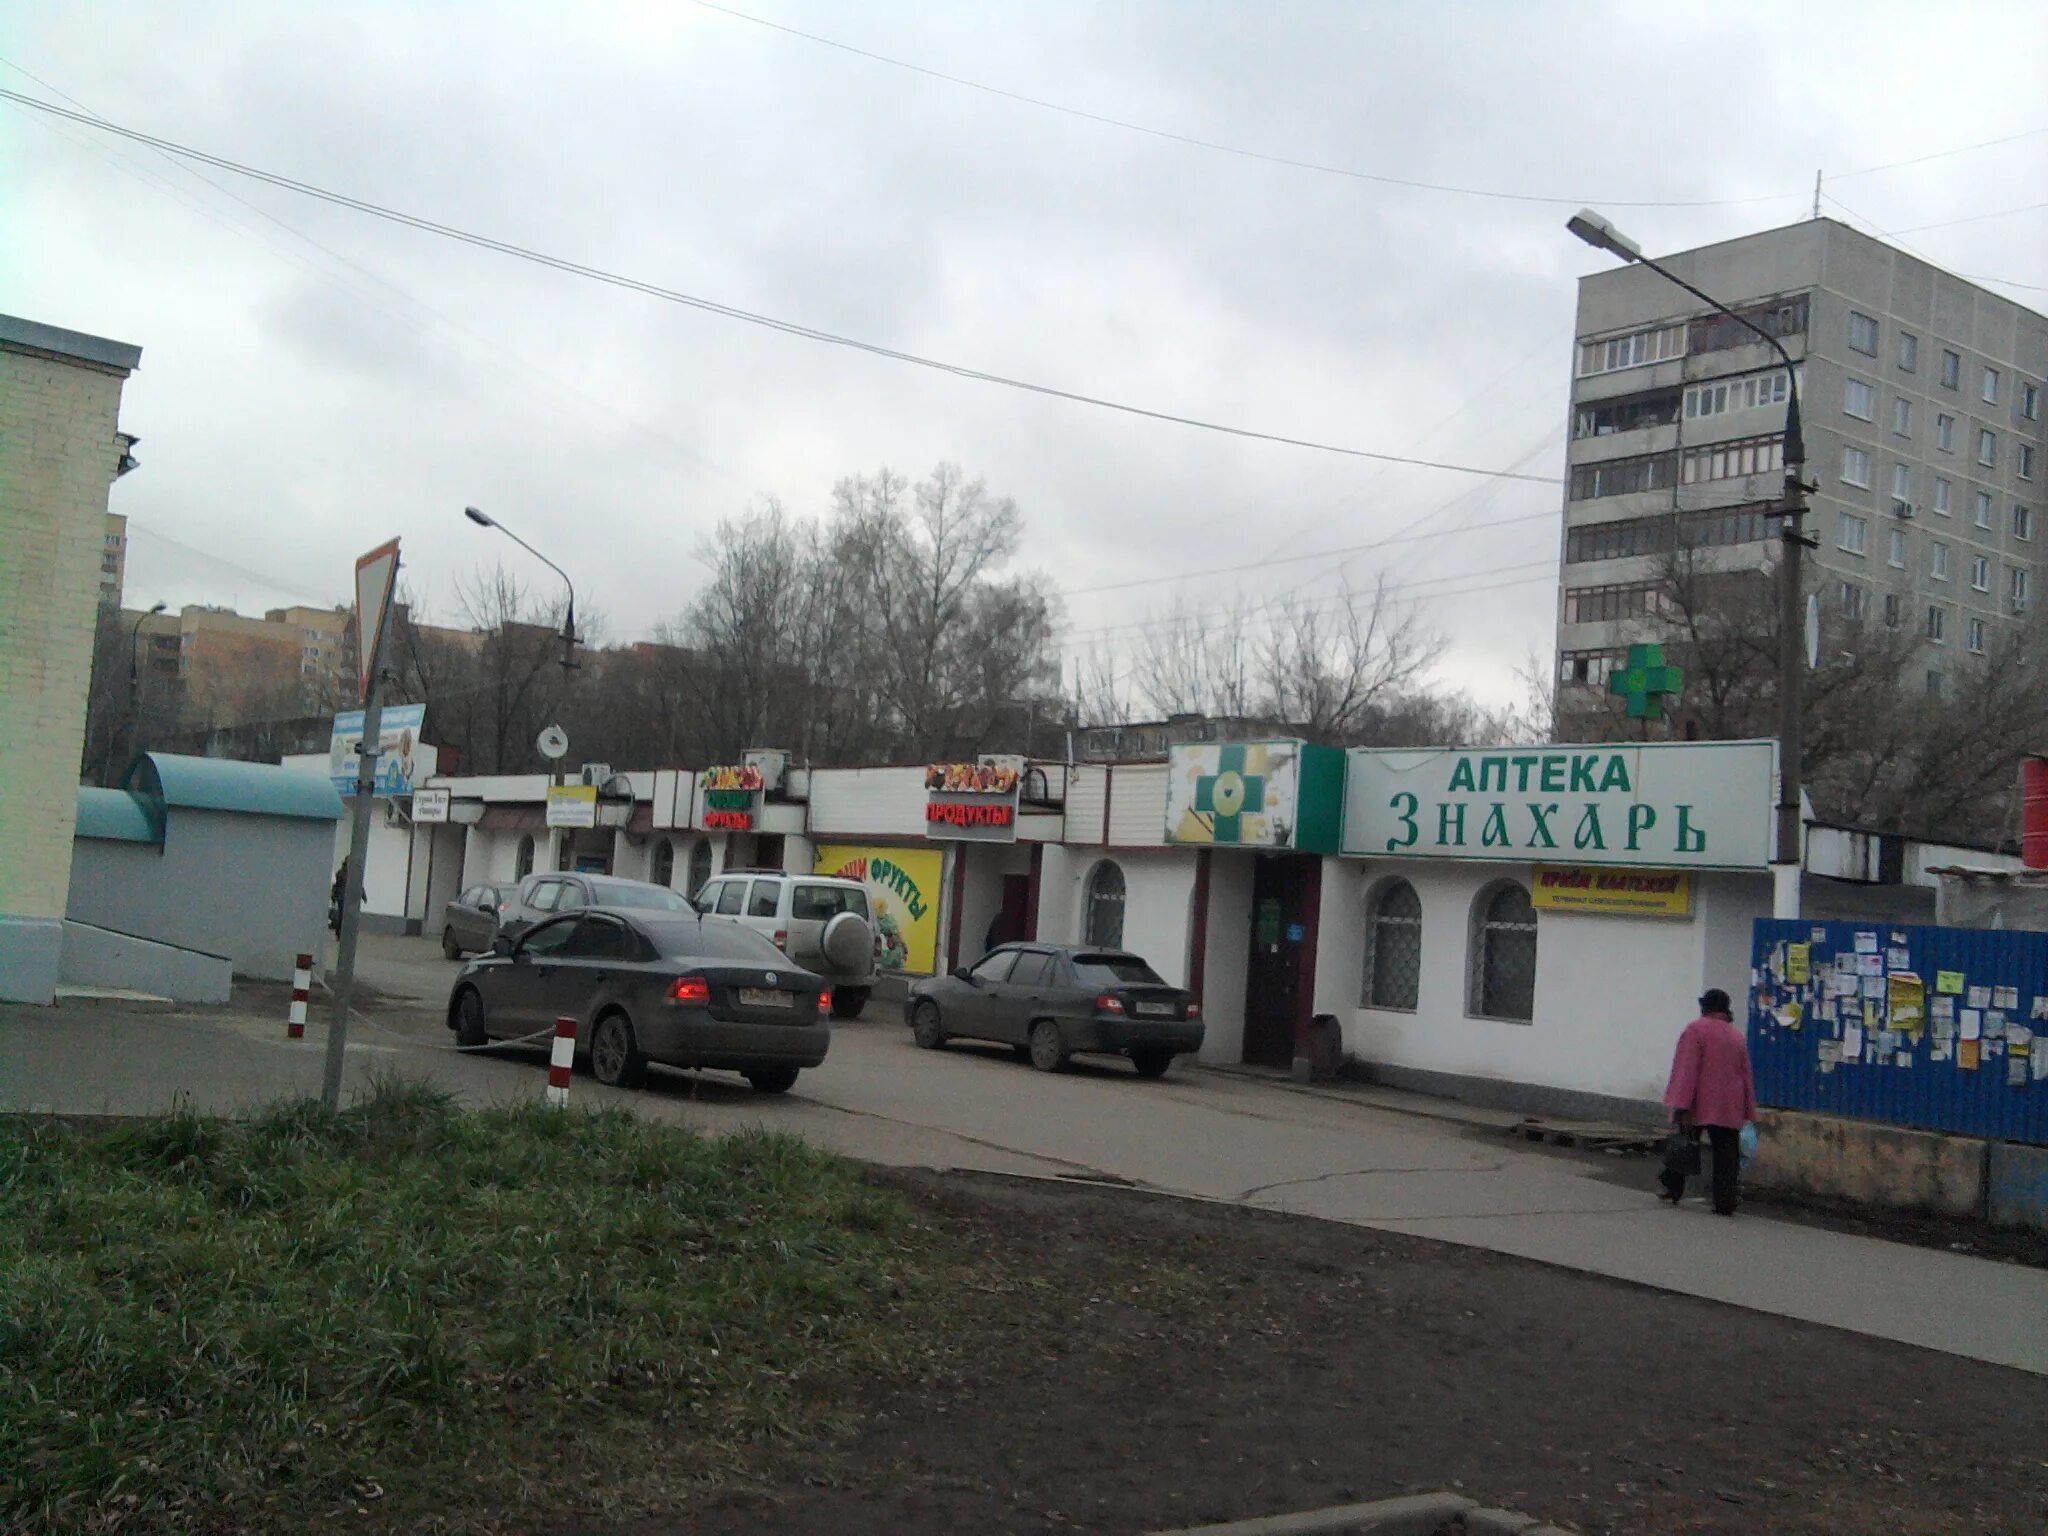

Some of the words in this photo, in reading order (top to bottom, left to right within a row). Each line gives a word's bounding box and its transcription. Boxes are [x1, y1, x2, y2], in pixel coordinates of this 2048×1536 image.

[1447, 755, 1632, 792] АПТЕКА
[927, 803, 1012, 827] ПРОДУКТЫ
[1386, 791, 1706, 852] ЗНАХАРЬ
[871, 857, 928, 922] ФРУКТЫ
